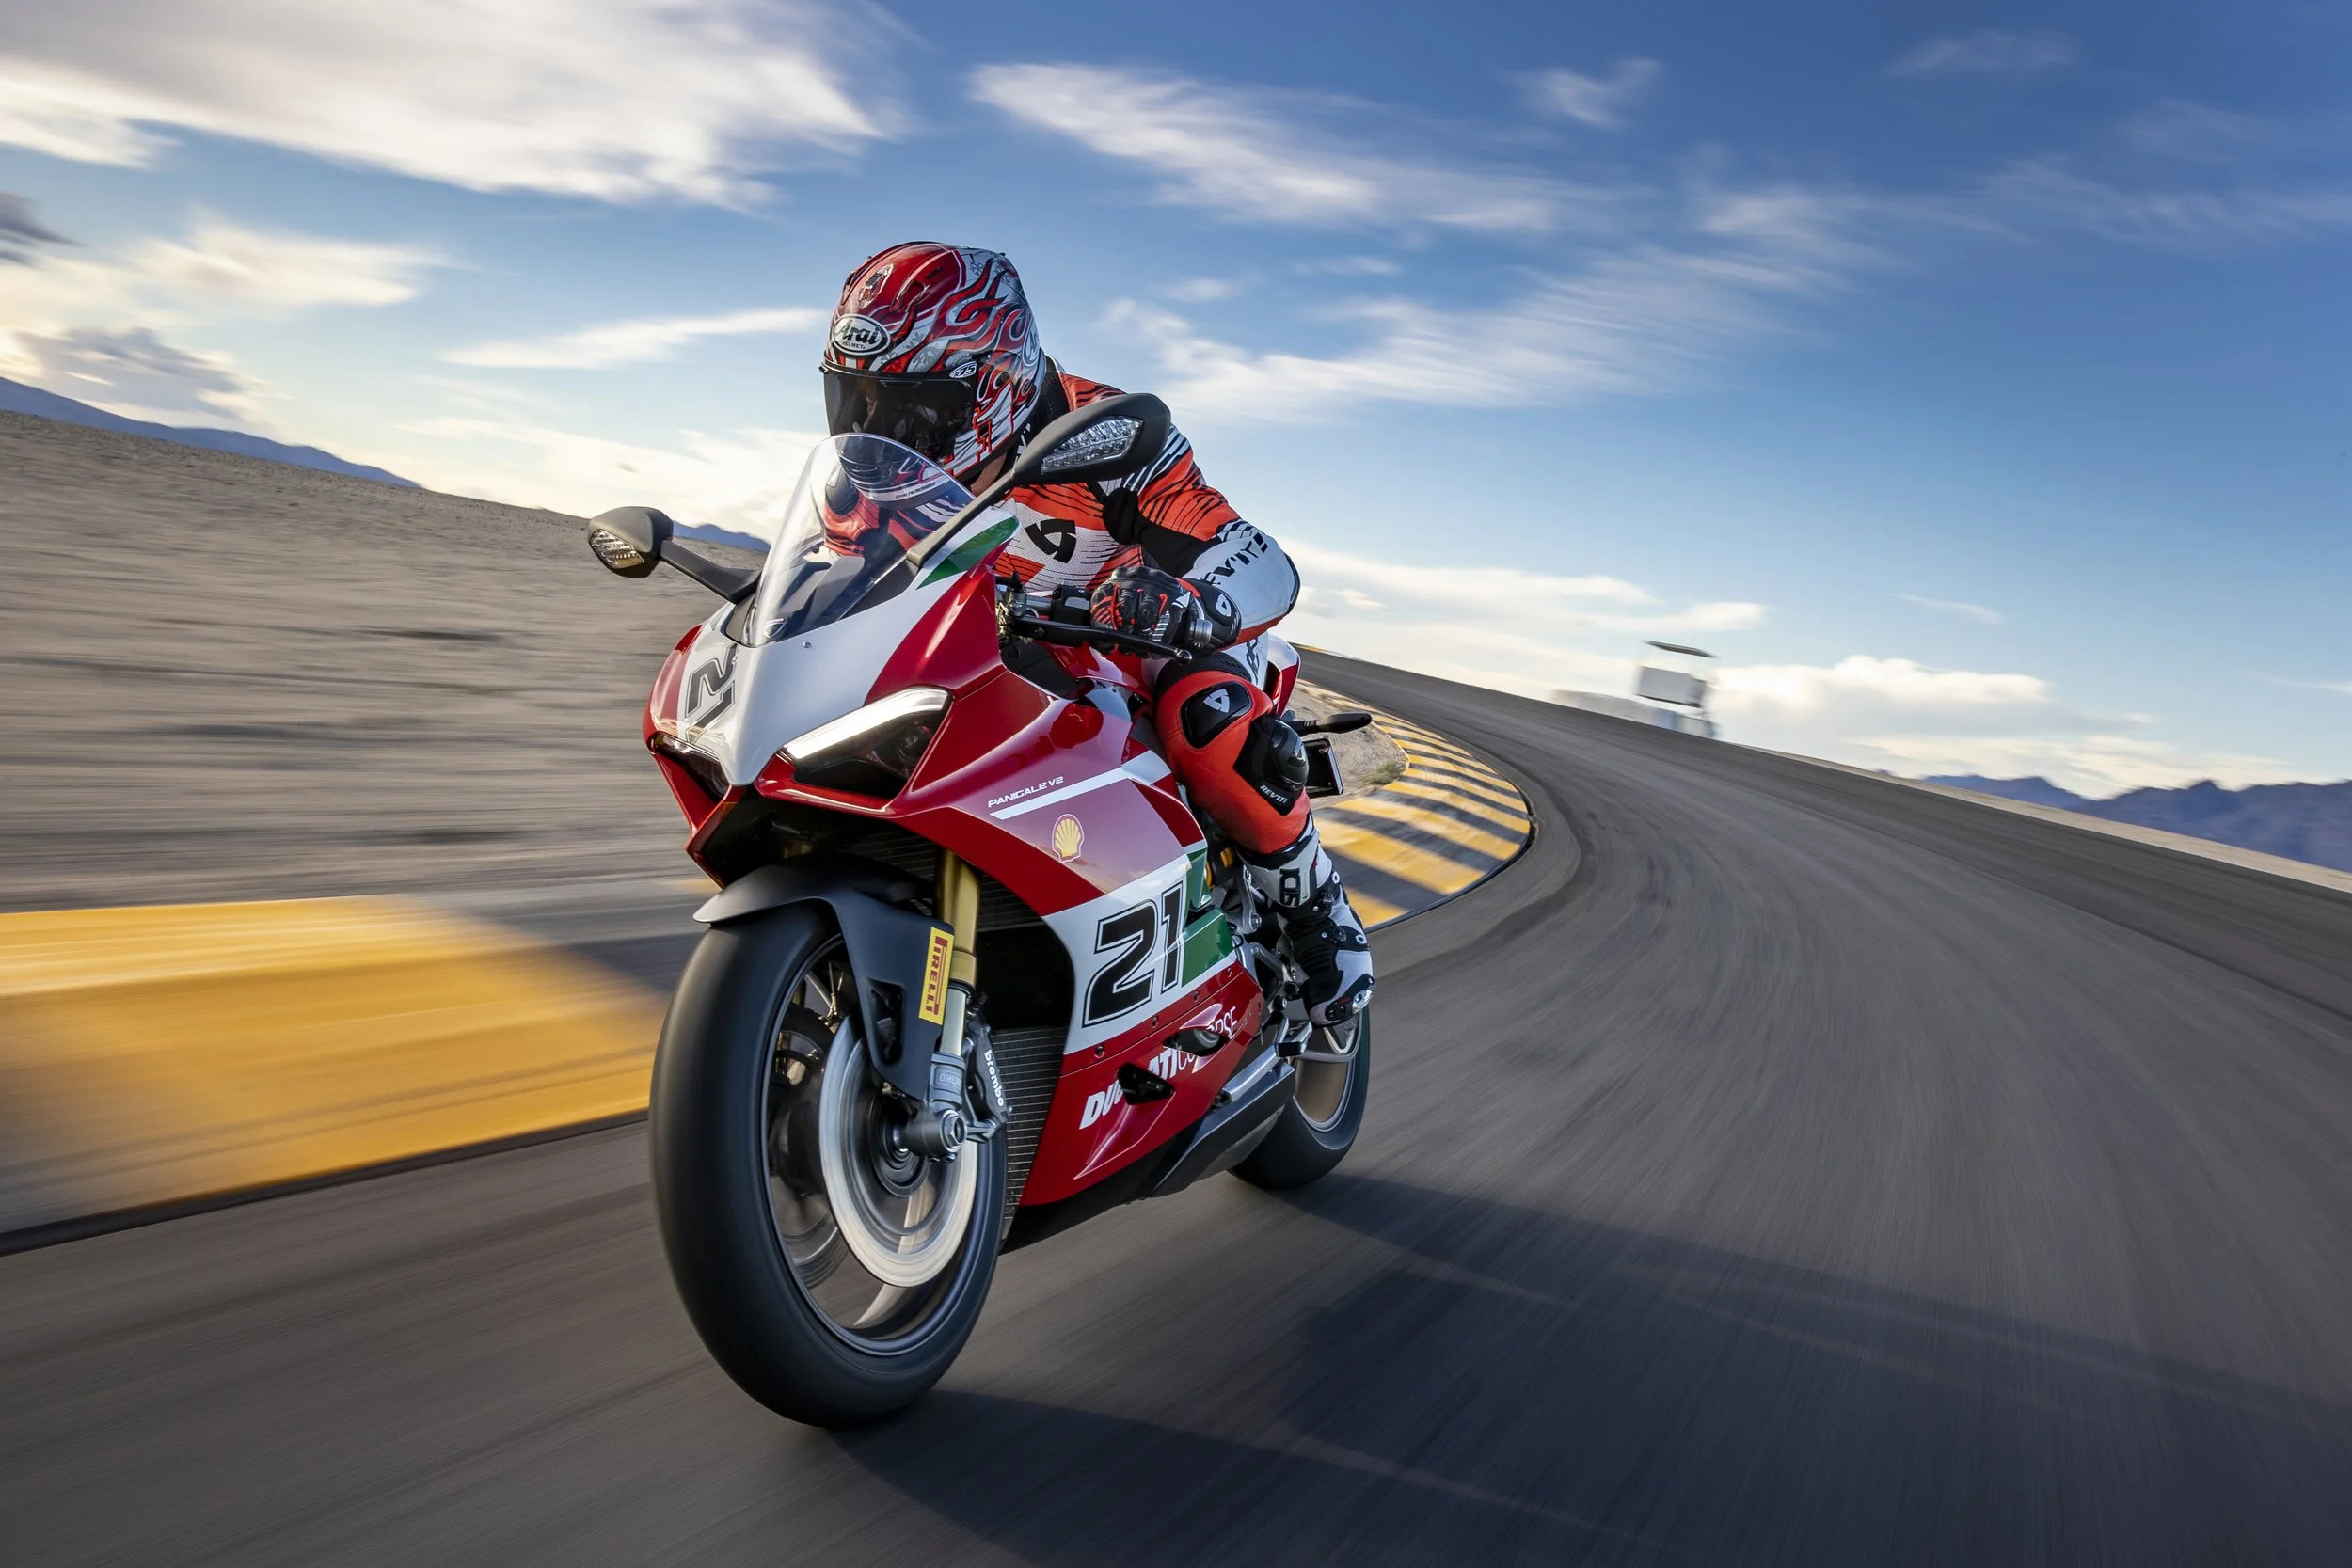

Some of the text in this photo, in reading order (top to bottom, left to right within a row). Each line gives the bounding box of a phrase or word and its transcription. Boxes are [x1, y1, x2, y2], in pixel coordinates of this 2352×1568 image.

[834, 319, 880, 345] Arai
[988, 776, 1064, 808] PANIGALE V2
[925, 936, 948, 1016] PIRELLI
[1081, 879, 1184, 1029] 21
[984, 1049, 1005, 1107] brembo
